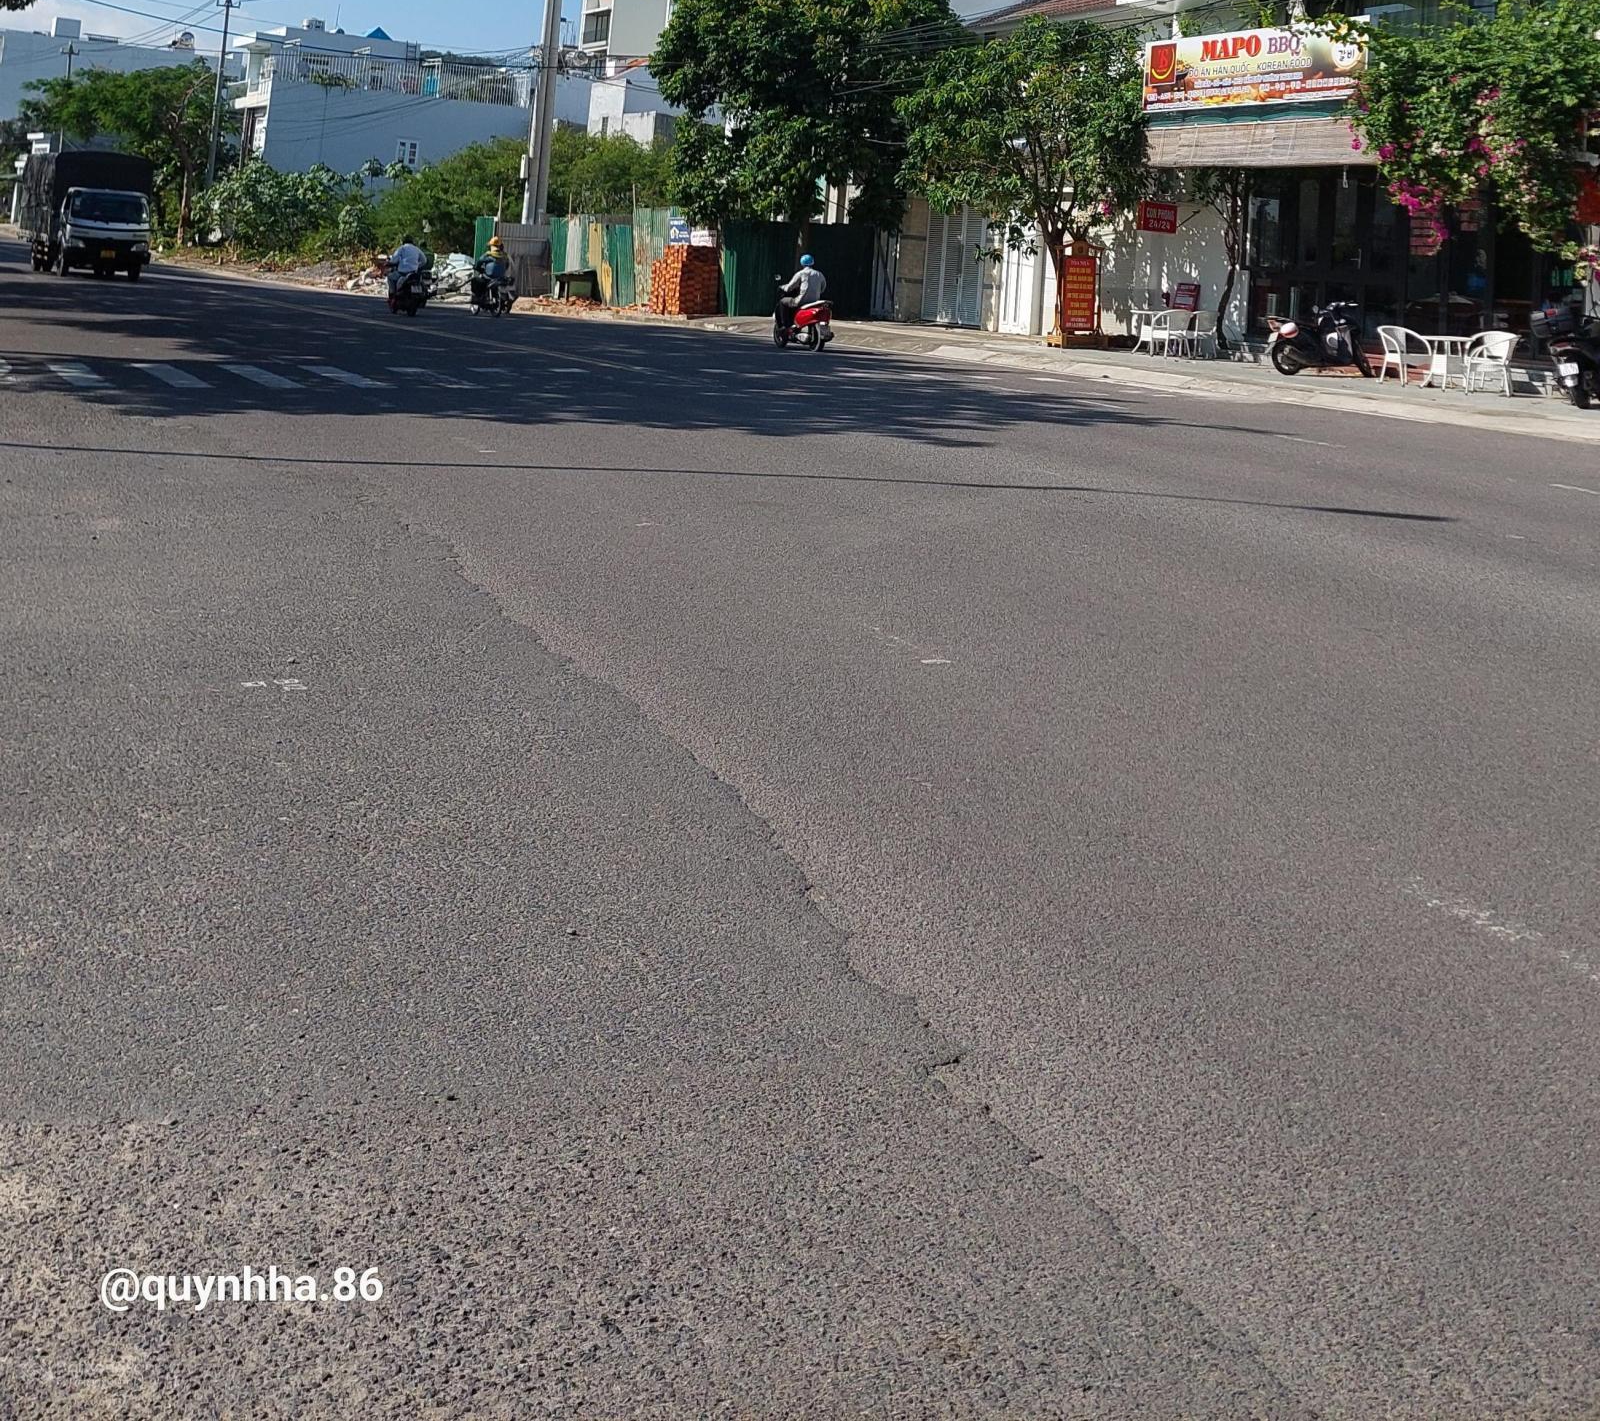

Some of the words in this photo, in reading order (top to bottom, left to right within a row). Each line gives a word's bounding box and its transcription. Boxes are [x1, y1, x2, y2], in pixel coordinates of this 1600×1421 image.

[1200, 34, 1262, 62] MAPO
[1266, 33, 1303, 56] BBQ
[1257, 59, 1289, 71] KOREAN
[1290, 57, 1312, 68] FOOD
